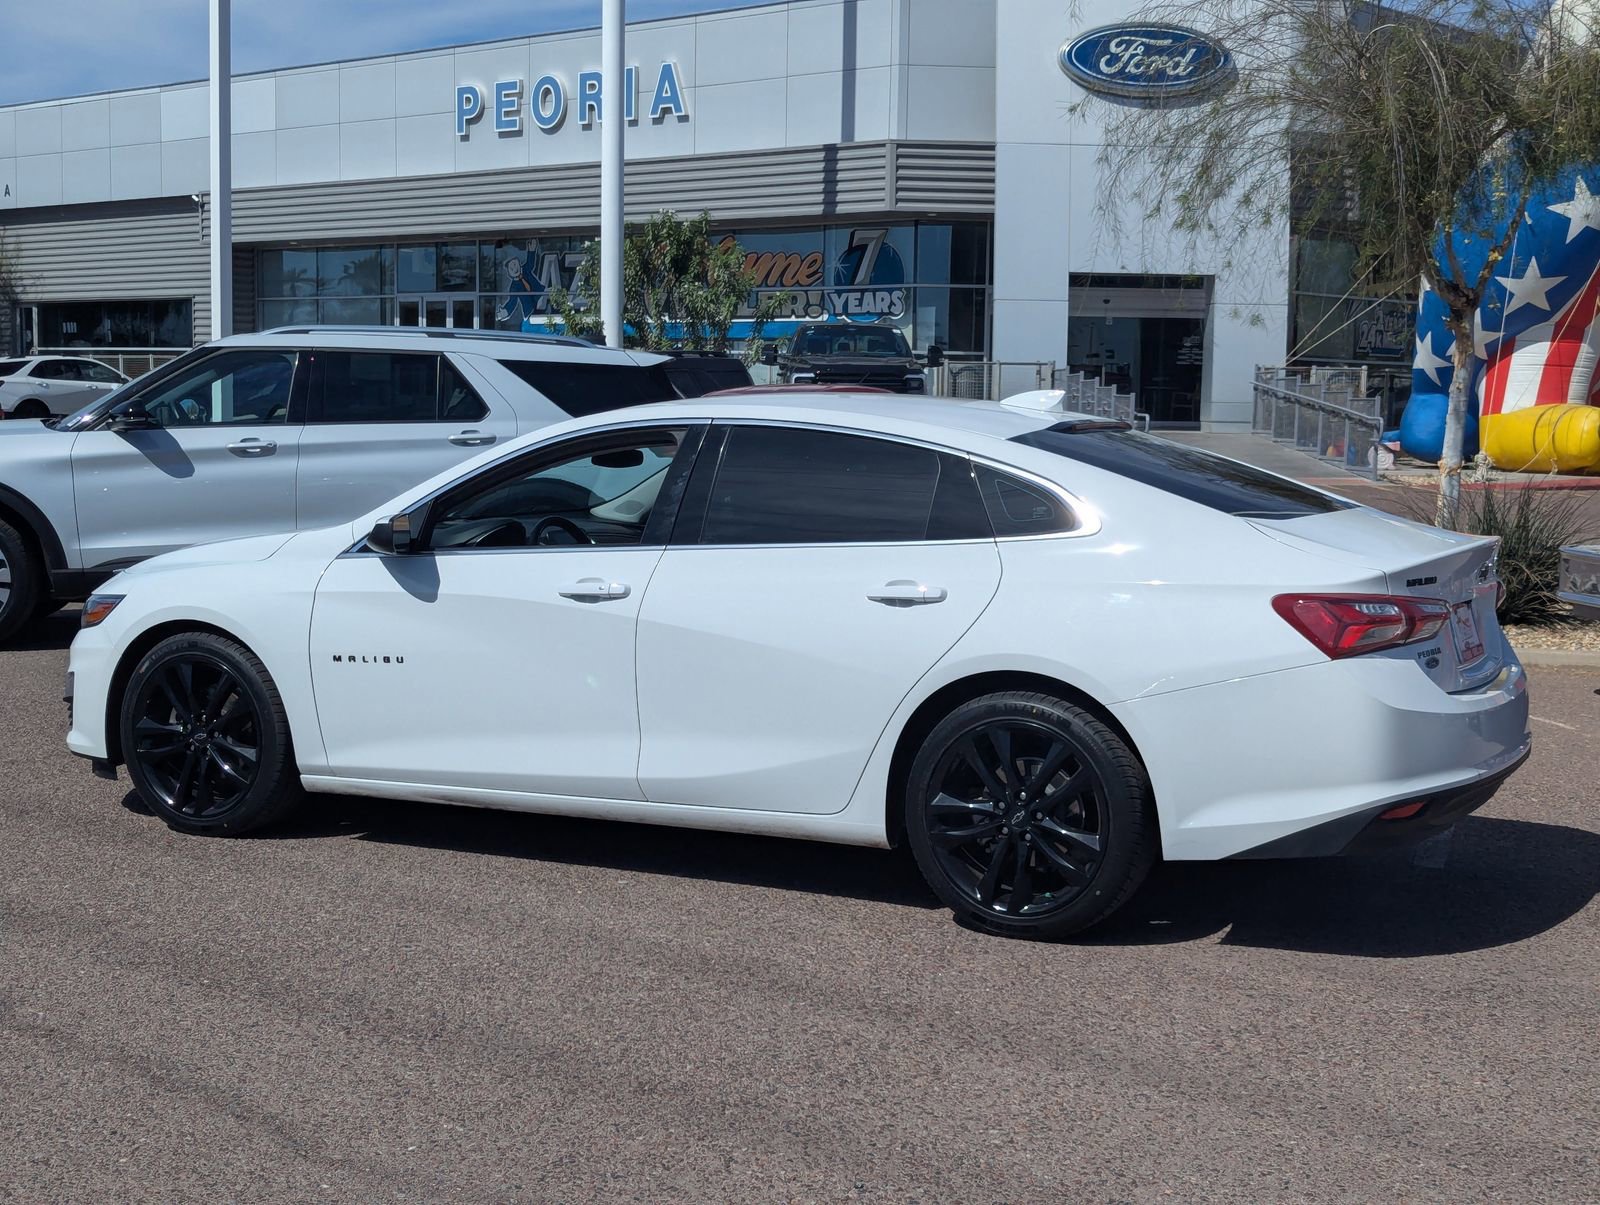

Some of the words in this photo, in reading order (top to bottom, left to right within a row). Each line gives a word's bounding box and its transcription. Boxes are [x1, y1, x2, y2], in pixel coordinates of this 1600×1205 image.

[1100, 36, 1197, 76] Ford
[456, 62, 686, 136] PEORIA
[851, 229, 890, 286] 7
[829, 290, 905, 315] YEARS
[332, 654, 405, 664] MALIBU
[1417, 647, 1442, 659] PEORIA
